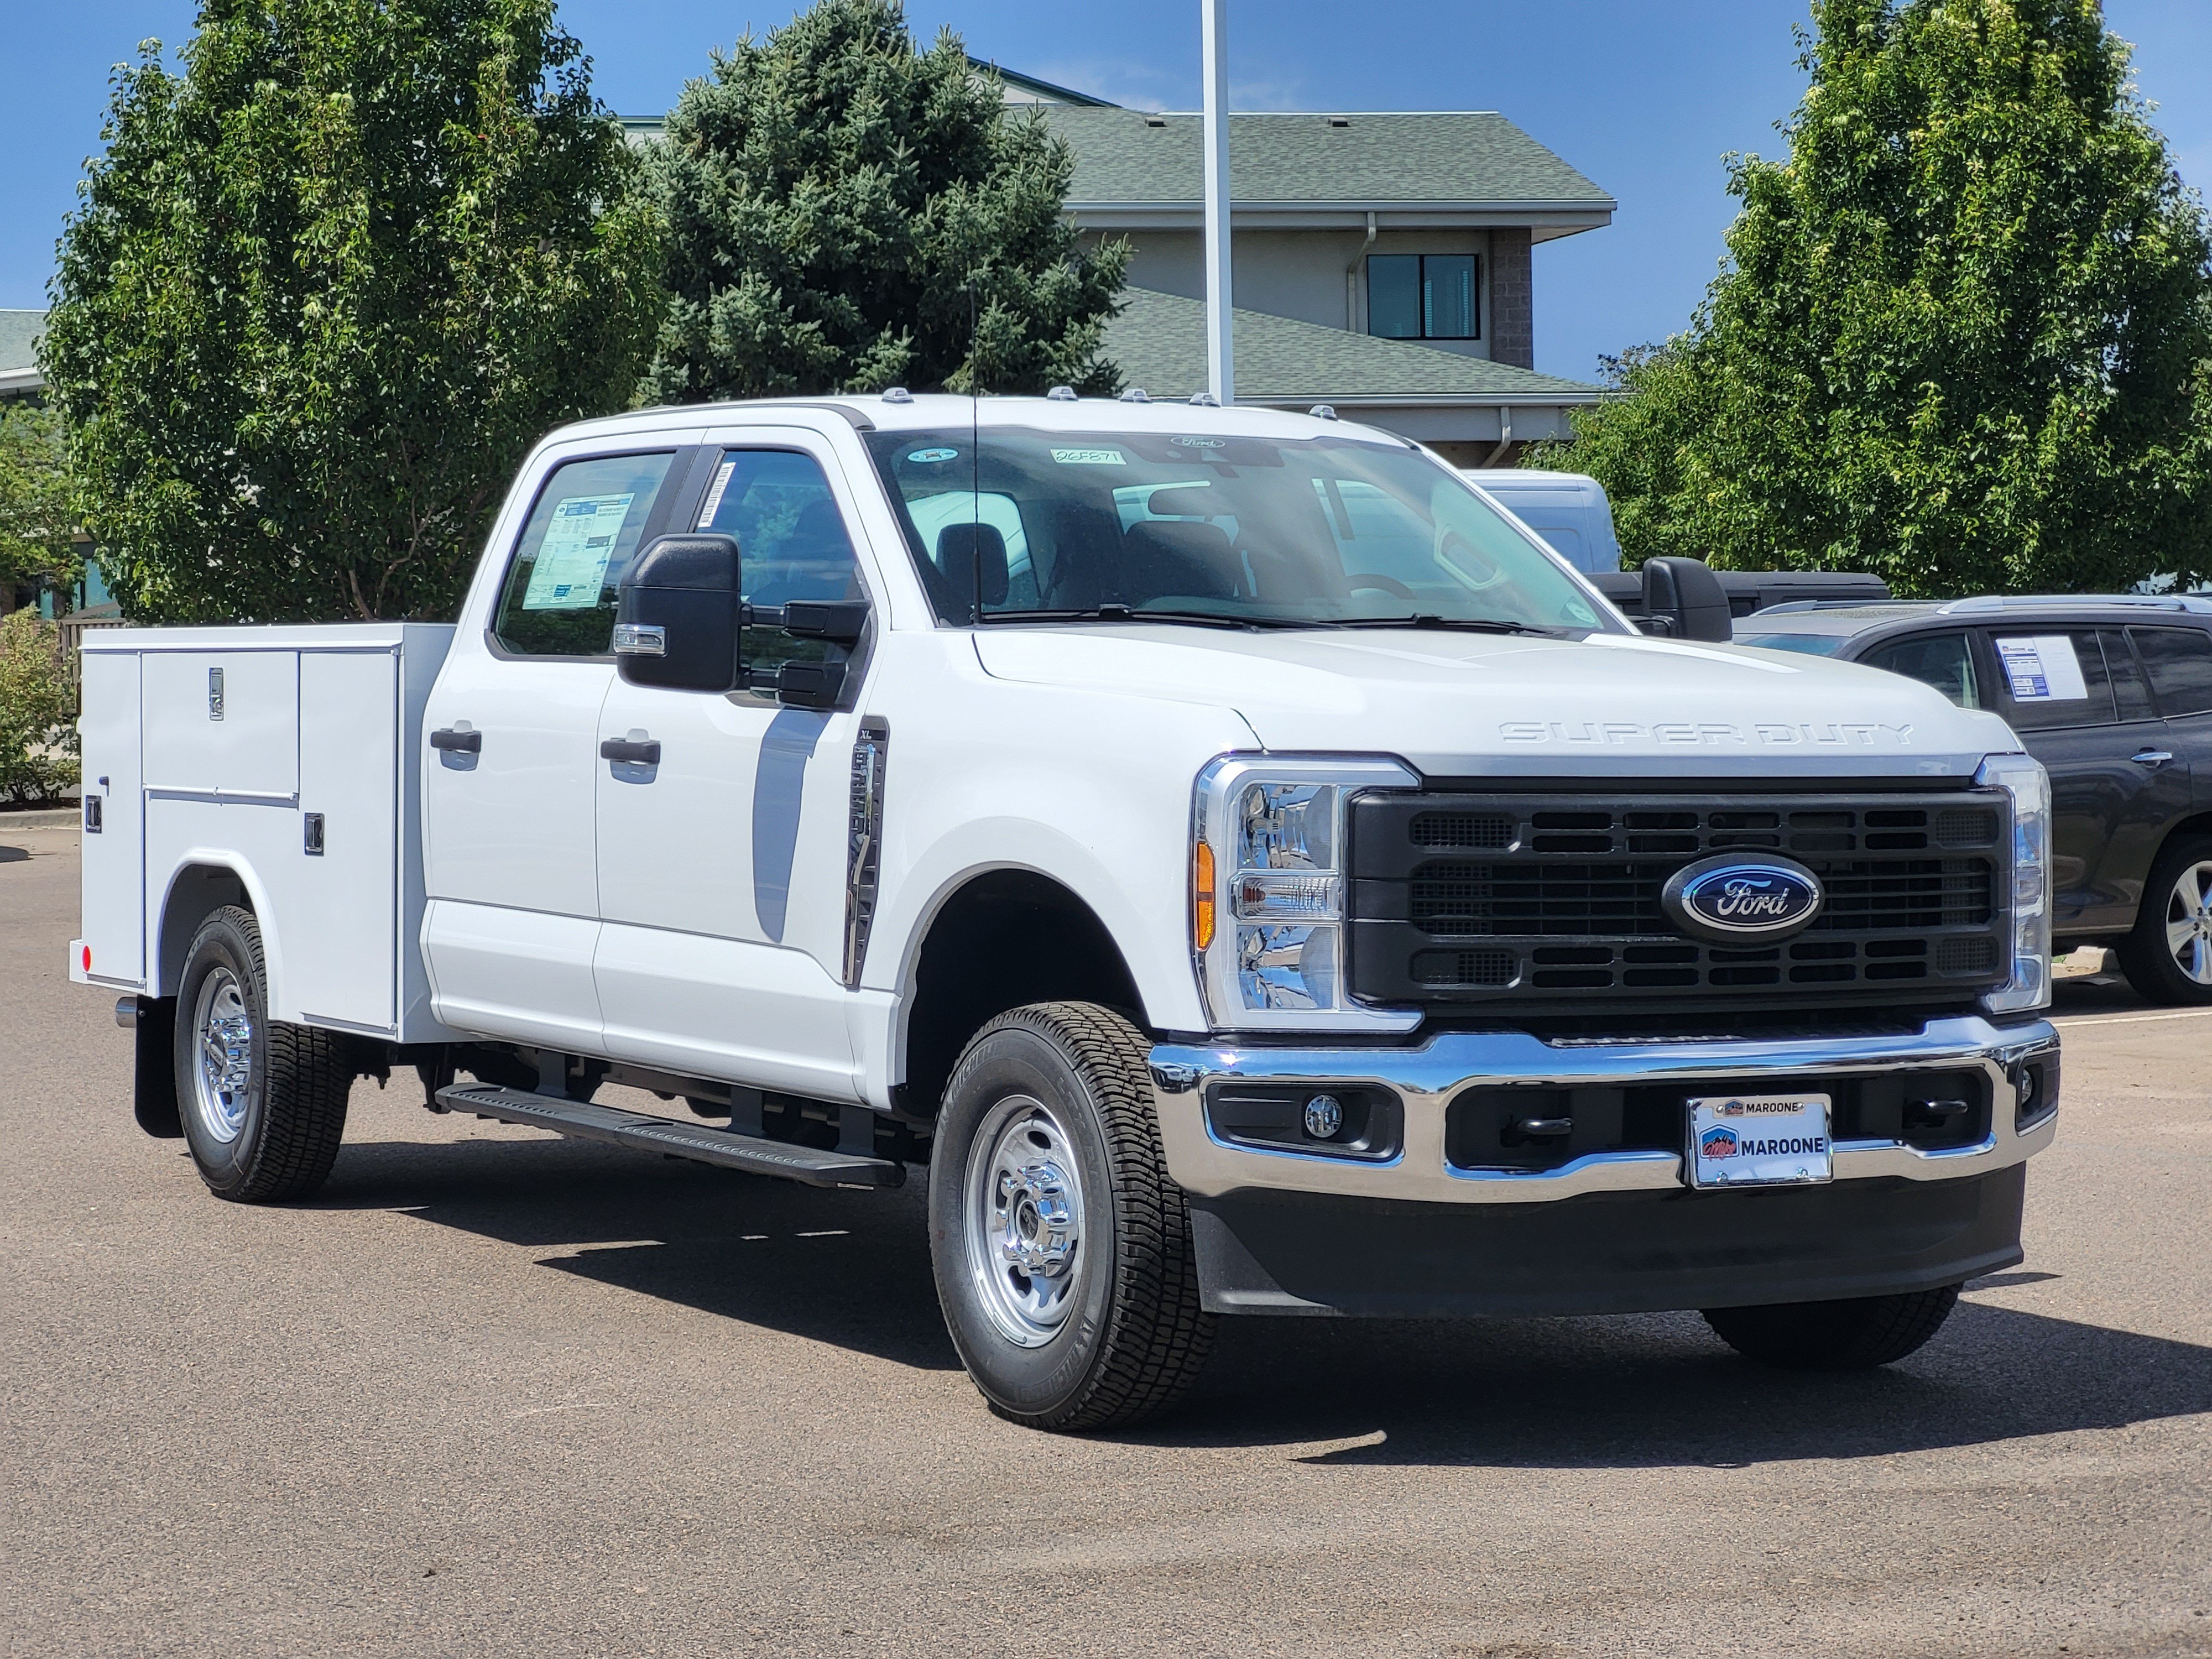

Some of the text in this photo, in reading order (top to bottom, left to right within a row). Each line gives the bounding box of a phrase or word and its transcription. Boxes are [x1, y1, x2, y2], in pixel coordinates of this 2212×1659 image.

[1056, 451, 1118, 461] 26F871
[860, 730, 872, 740] XL
[1498, 722, 1914, 745] SUPER DUTY
[1717, 878, 1790, 916] Ford
[1746, 1102, 1798, 1113] MAROONE
[1741, 1138, 1824, 1156] MAROONE
